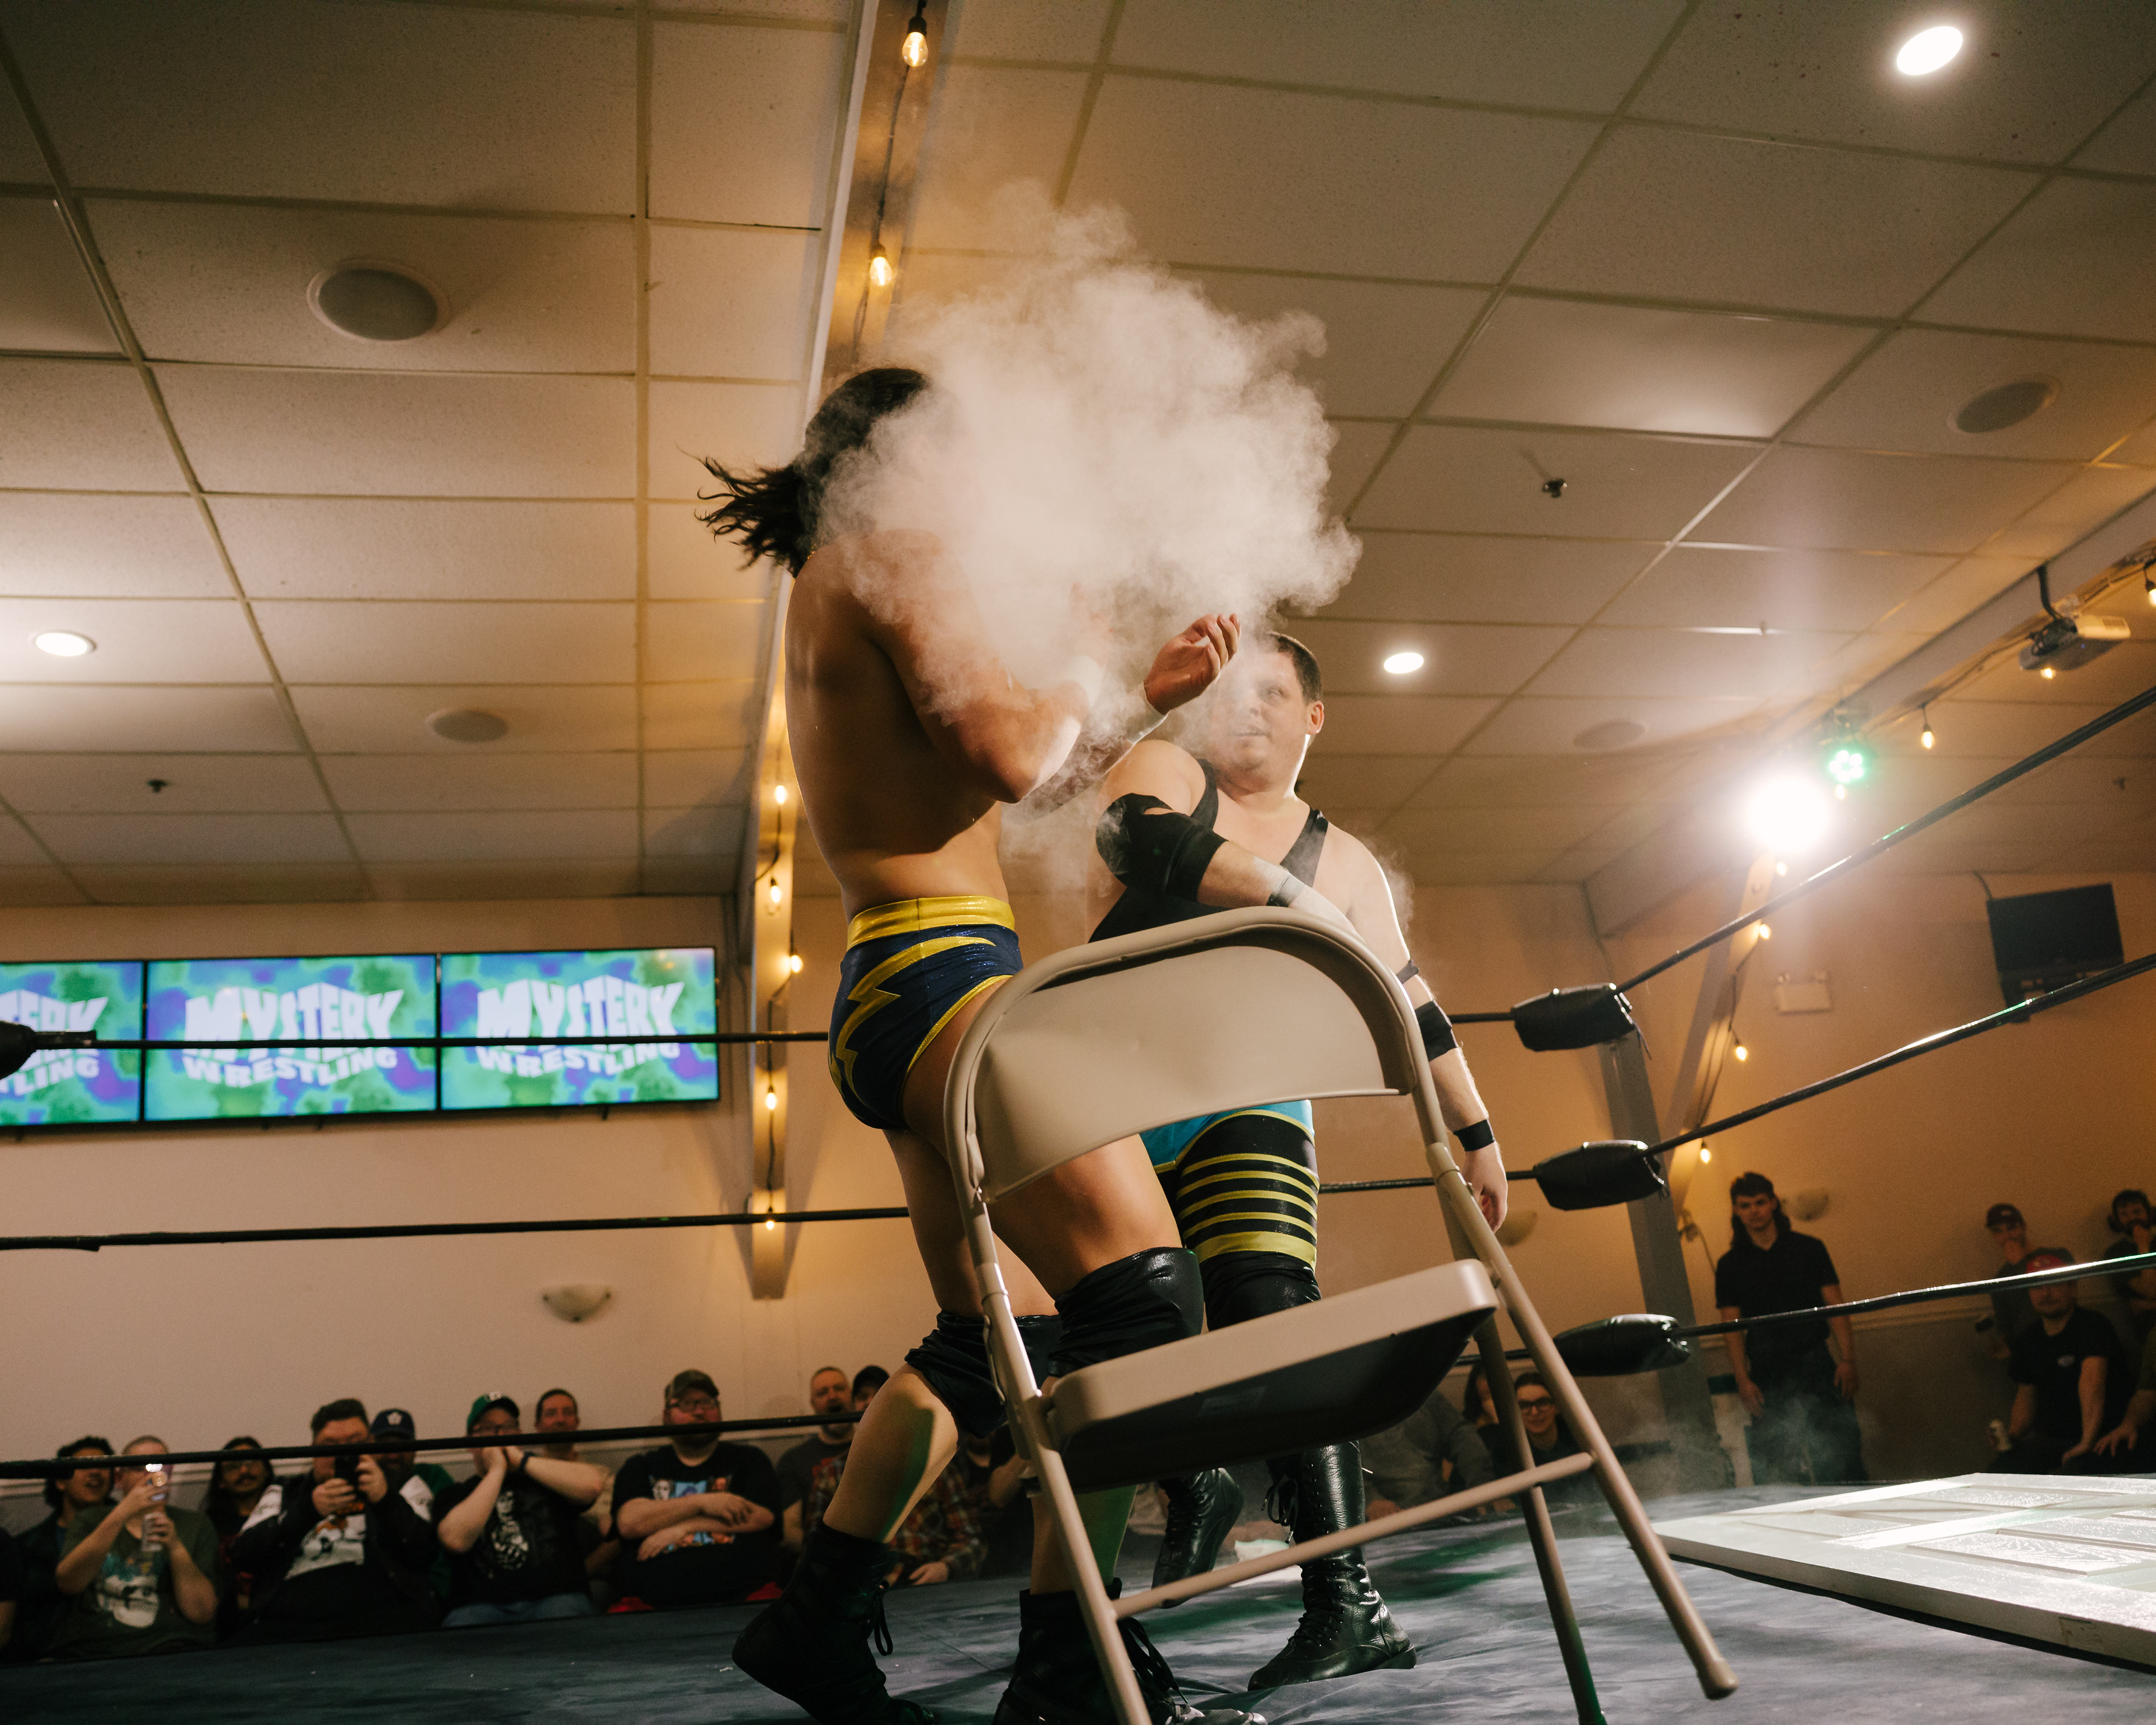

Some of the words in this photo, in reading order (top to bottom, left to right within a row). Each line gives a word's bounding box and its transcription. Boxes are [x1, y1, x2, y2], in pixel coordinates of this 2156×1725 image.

[182, 983, 404, 1064] MYSTERY
[476, 974, 685, 1053] MYSTERY
[182, 1047, 398, 1088] WRESTLING
[475, 1043, 680, 1078] WRESTLING
